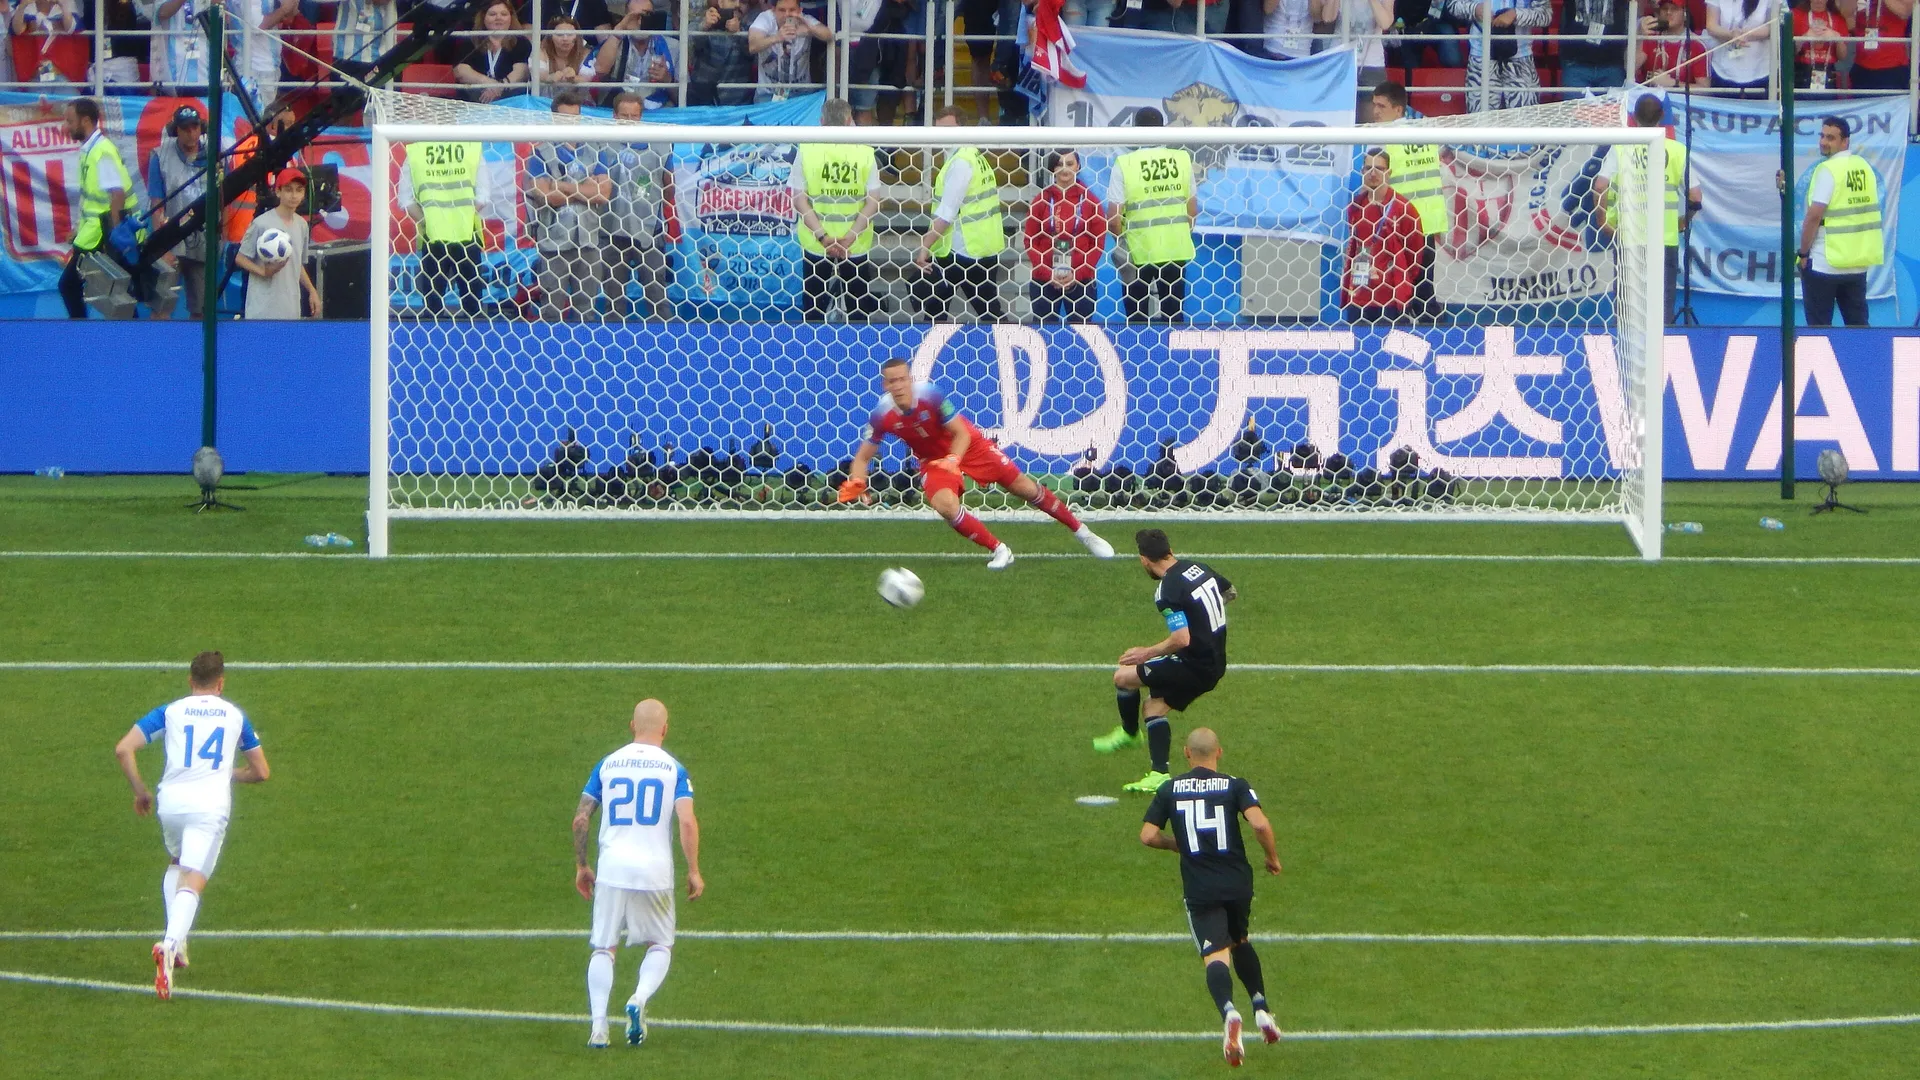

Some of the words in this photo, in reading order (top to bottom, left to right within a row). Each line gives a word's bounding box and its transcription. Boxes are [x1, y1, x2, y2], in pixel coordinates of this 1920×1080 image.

[425, 144, 465, 165] 5210
[821, 161, 858, 184] 4321
[1140, 158, 1179, 182] 5253
[700, 181, 793, 219] ARGENTINA
[1144, 183, 1182, 194] SEWARD
[728, 260, 786, 278] RUSSA
[1485, 264, 1597, 301] JUANILLO
[1169, 325, 1563, 478] 万达
[1190, 576, 1227, 633] 10
[184, 707, 227, 717] ARNASON
[183, 724, 225, 770] 14
[1172, 777, 1230, 793] MASCHERANO
[609, 777, 665, 827] 20
[1176, 799, 1228, 853] 14
